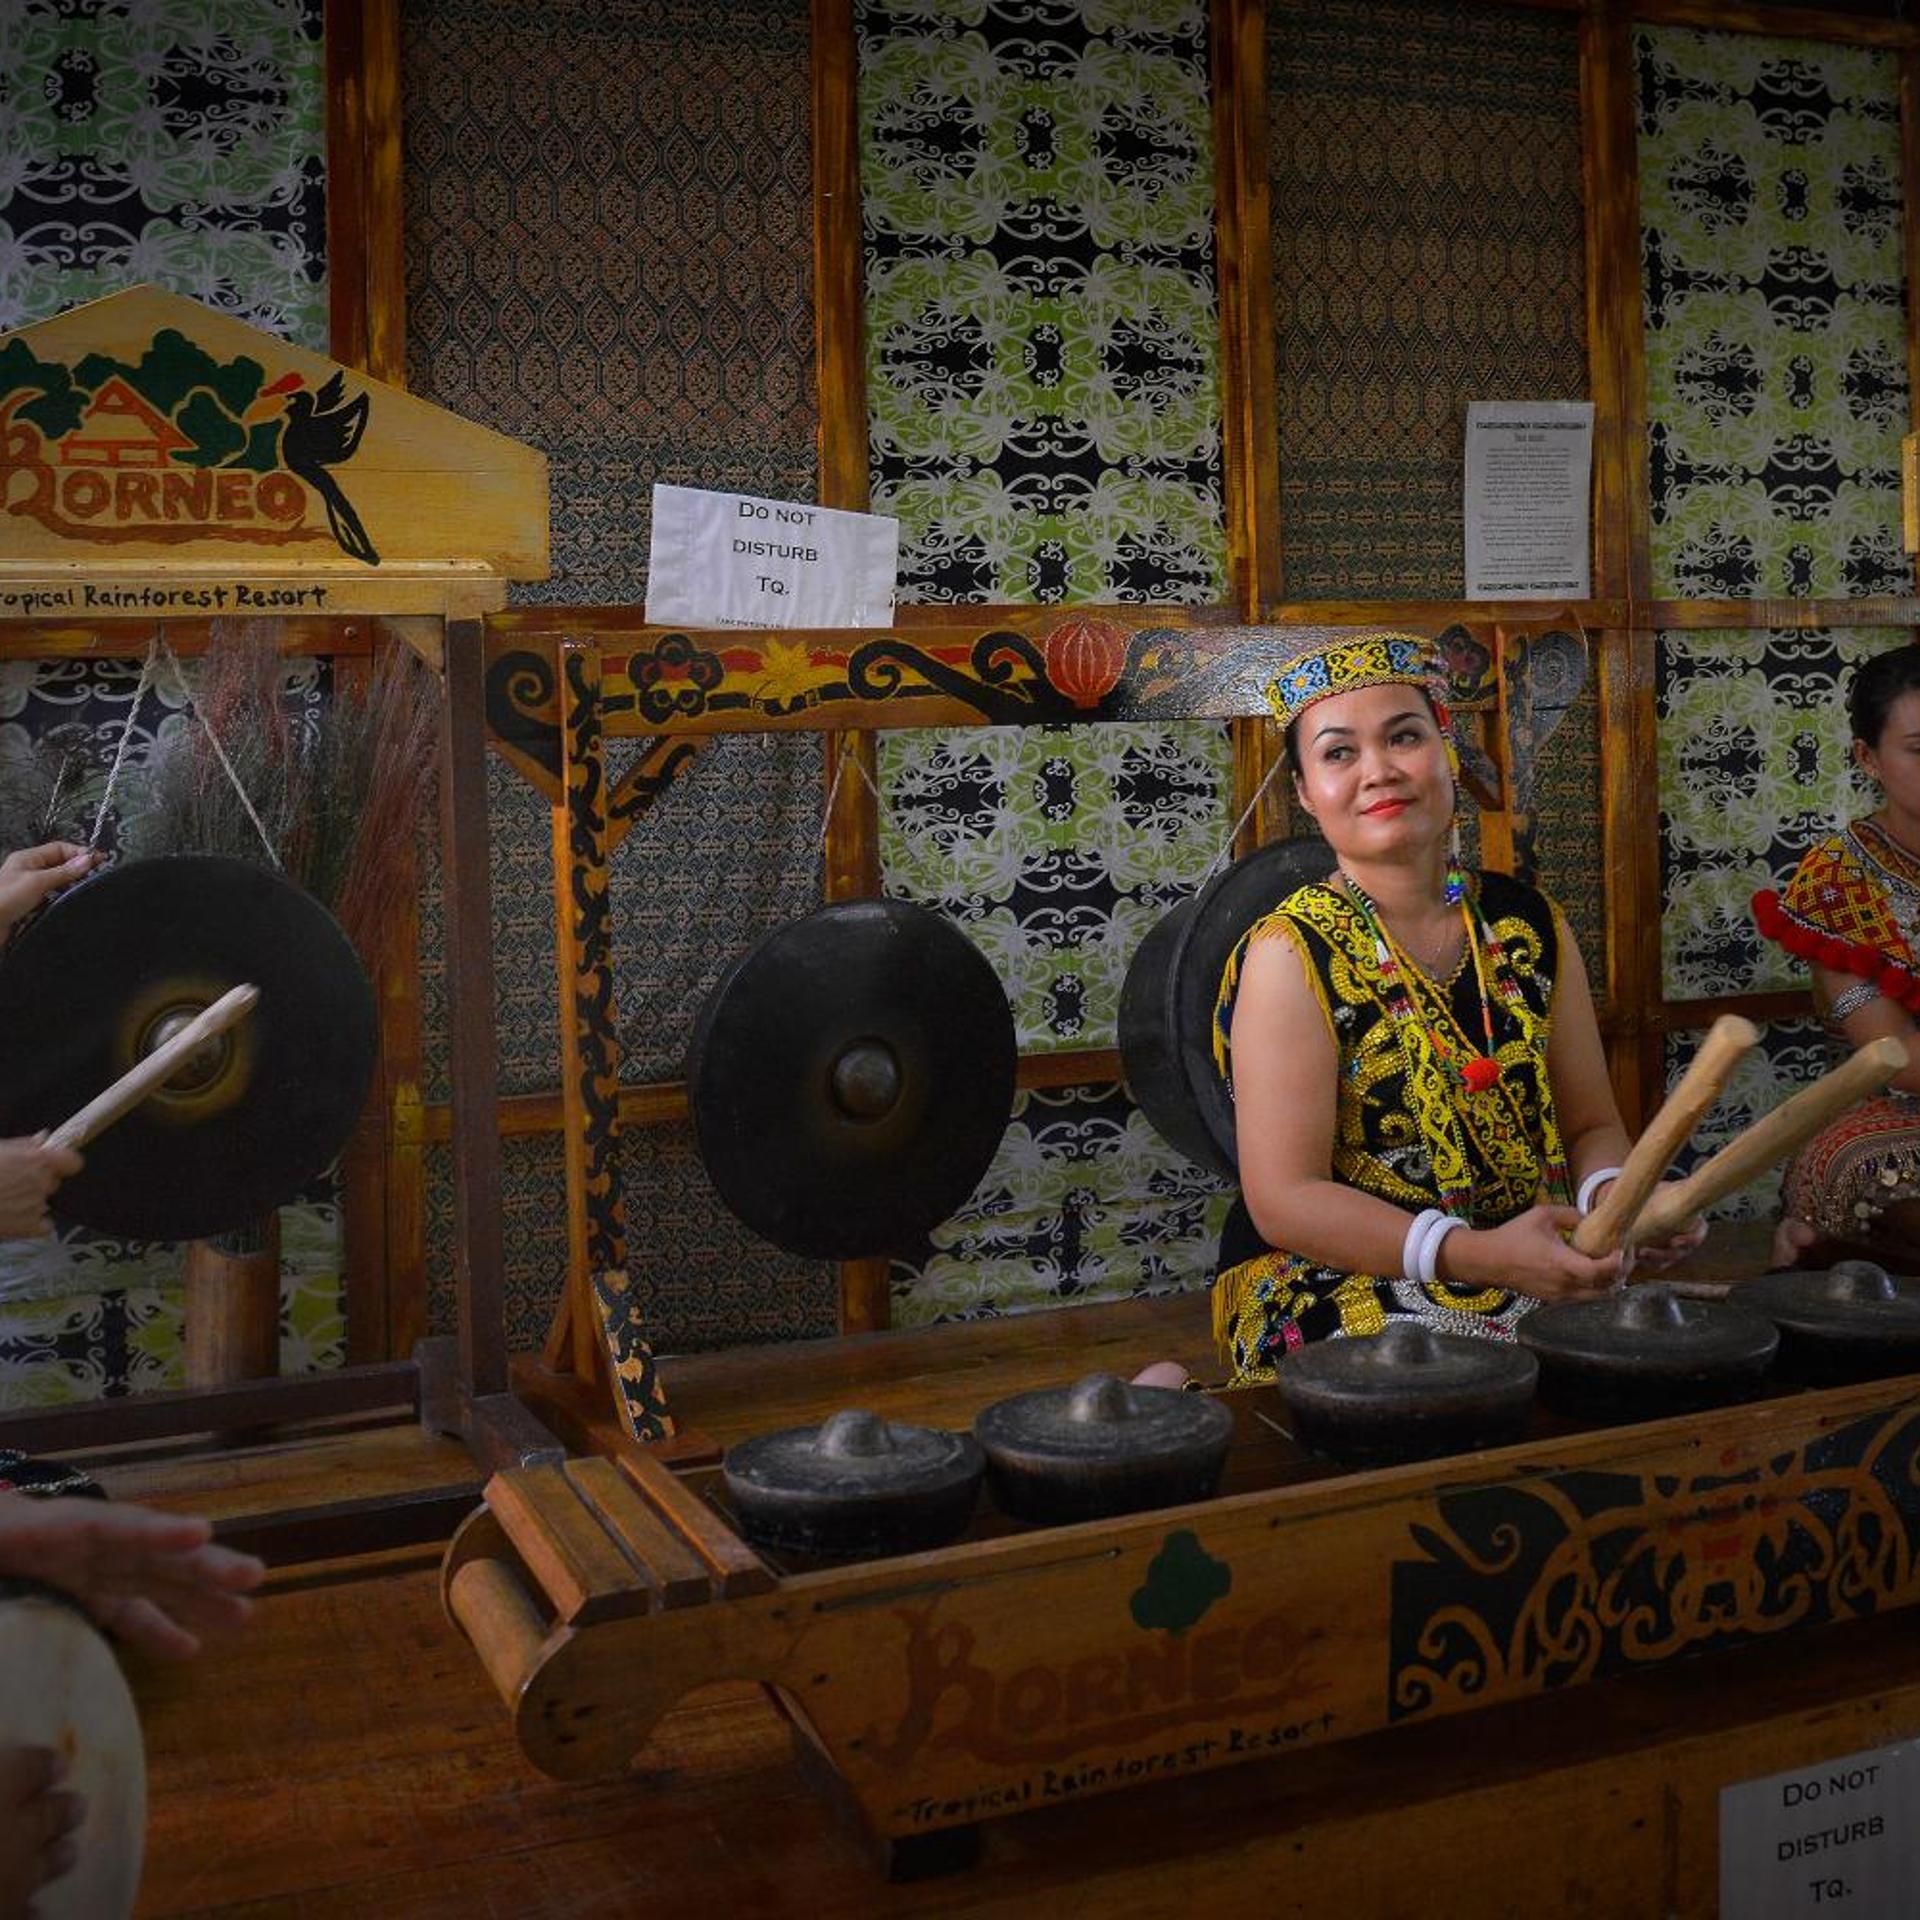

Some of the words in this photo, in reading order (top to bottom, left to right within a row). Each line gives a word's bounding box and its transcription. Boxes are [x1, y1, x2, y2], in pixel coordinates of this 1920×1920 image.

[775, 508, 817, 526] NOT
[732, 538, 818, 562] DISTURB
[84, 584, 229, 609] Rainforest
[235, 583, 328, 609] Resort
[1043, 1738, 1219, 1797] Rainforest
[1228, 1711, 1335, 1752] Resort
[1829, 1765, 1880, 1796] NOT
[1777, 1815, 1885, 1862] DISTURB
